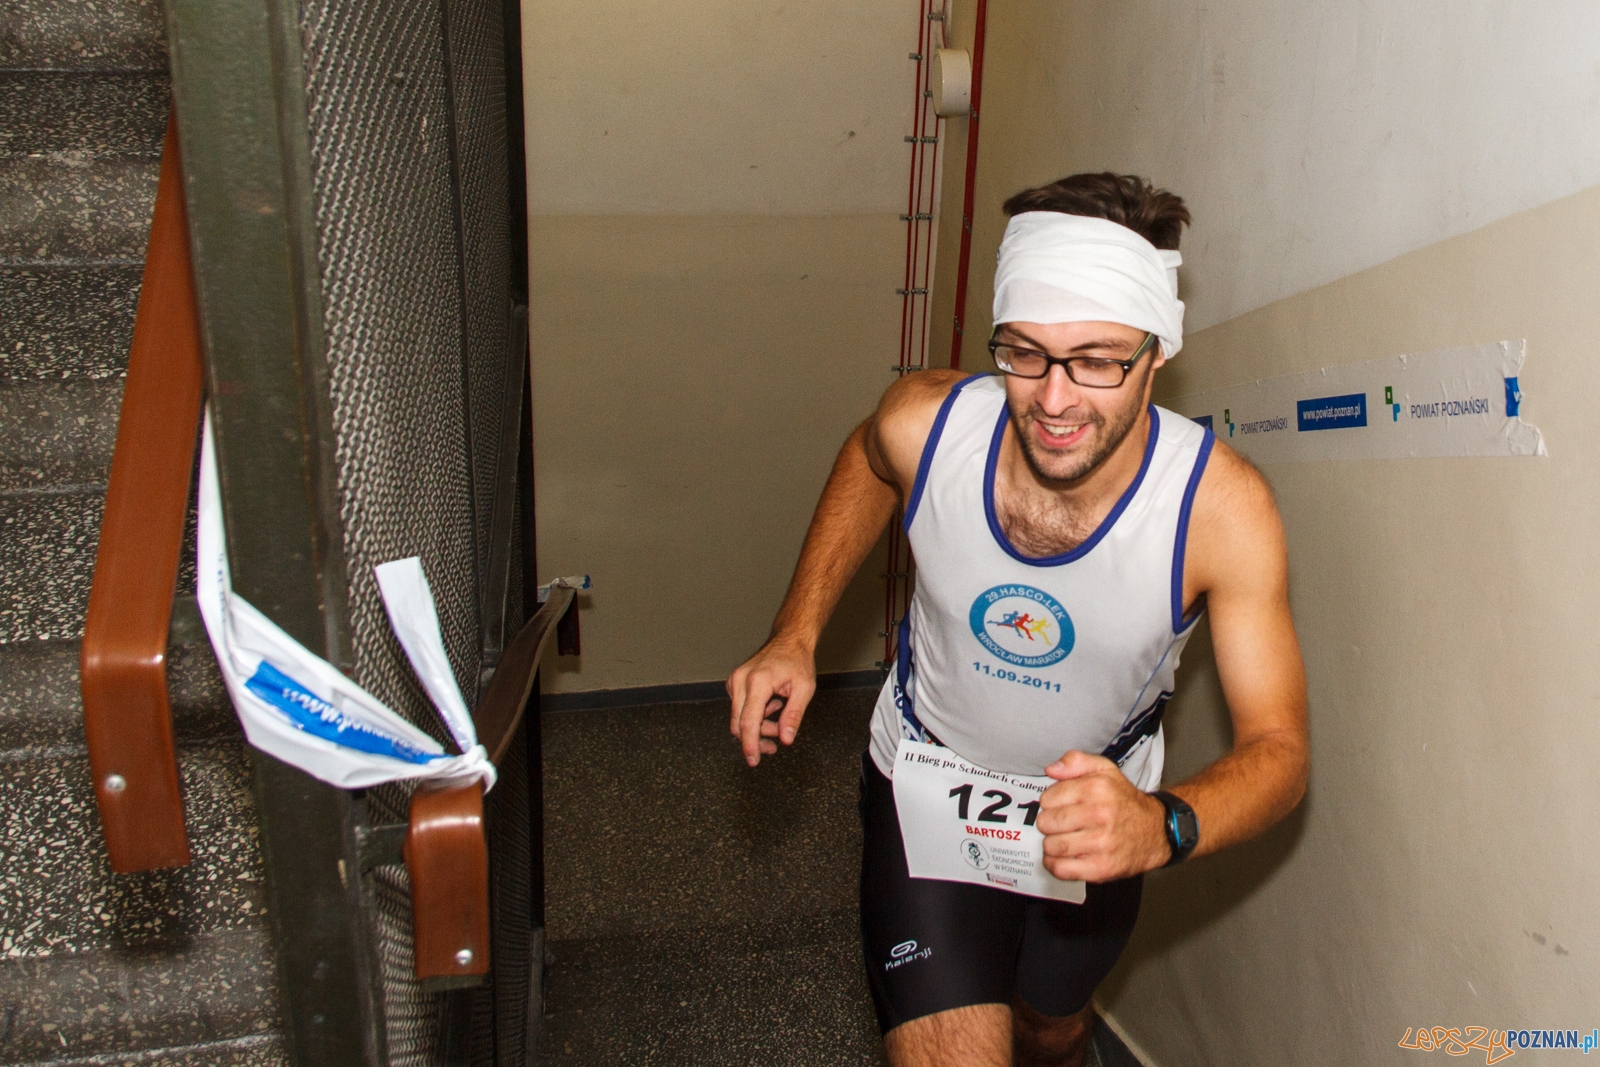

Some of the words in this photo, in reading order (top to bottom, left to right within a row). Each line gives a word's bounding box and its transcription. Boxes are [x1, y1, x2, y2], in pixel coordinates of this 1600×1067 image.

[1303, 403, 1361, 421] www.powiat.poznan.pl
[1411, 403, 1439, 418] POWIAT
[1442, 396, 1489, 416] POZNAŃSKI
[1240, 421, 1258, 434] POWIAT
[1259, 416, 1288, 432] POZNAŃSKI
[1024, 647, 1065, 665] MARATON
[973, 662, 1061, 692] 11.09.2011
[904, 752, 914, 761] II
[917, 753, 940, 767] Bieg
[942, 760, 956, 769] po
[958, 764, 1008, 783] Schodach
[949, 783, 1041, 826] 121
[965, 825, 1021, 841] BARTOSZ
[990, 847, 1030, 858] UNIWERSYTET
[992, 855, 1034, 867] EKONOMICZNY
[1001, 865, 1032, 876] POZNANIU
